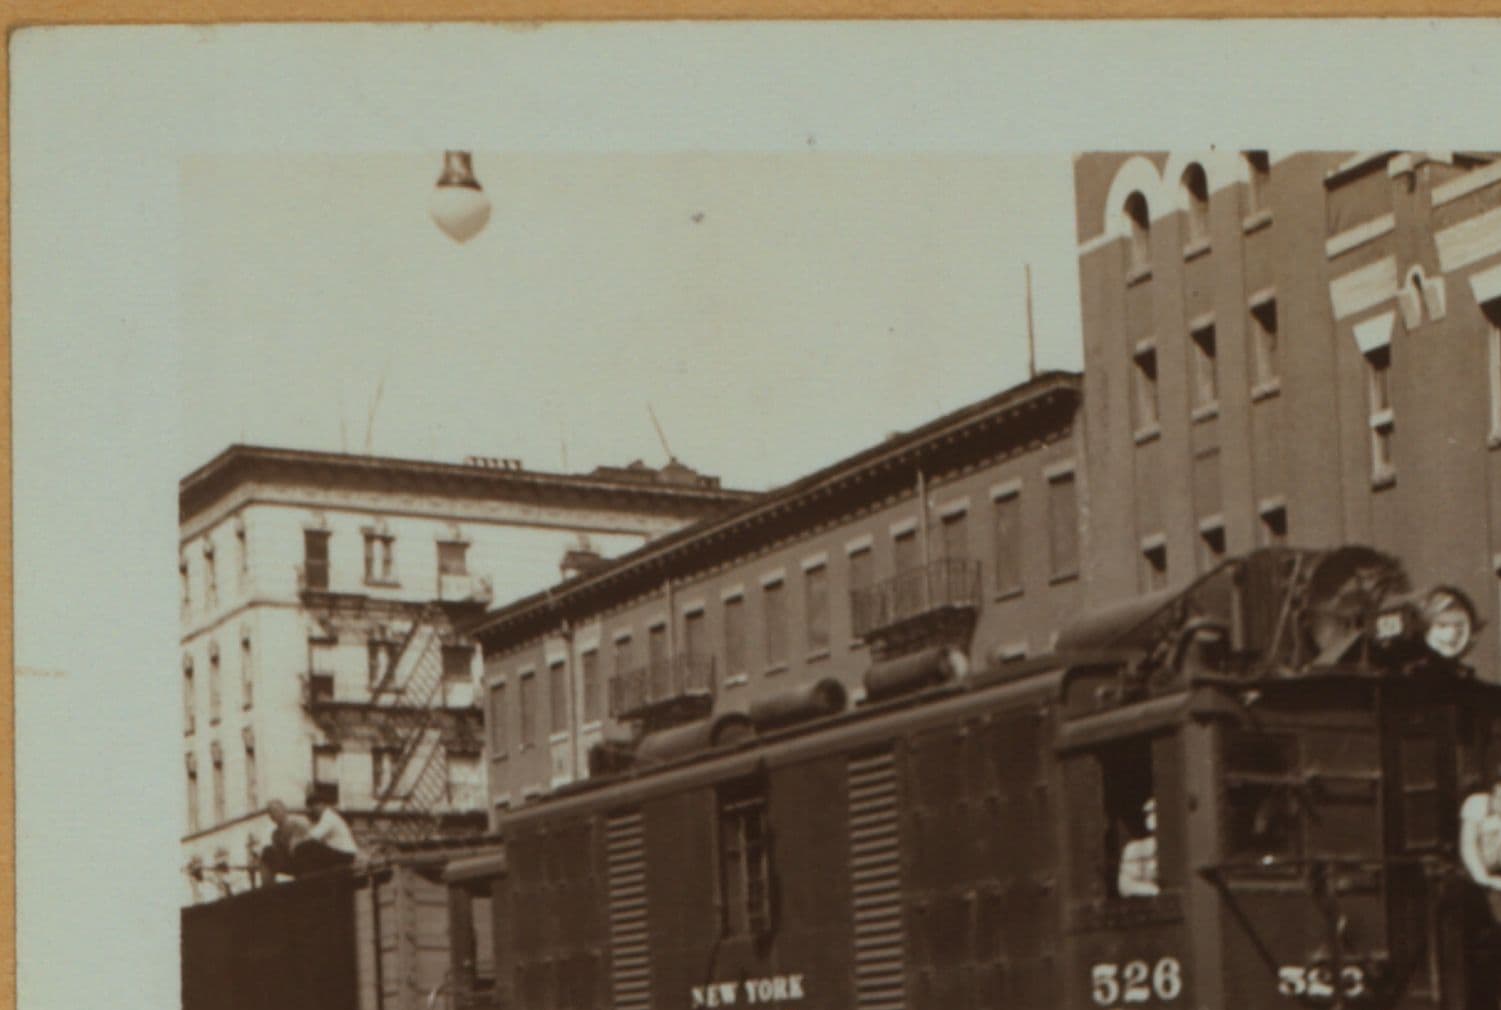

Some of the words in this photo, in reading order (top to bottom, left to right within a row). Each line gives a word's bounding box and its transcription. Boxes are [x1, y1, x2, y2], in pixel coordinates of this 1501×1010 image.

[691, 981, 738, 1009] NEW
[745, 973, 805, 1005] YORK
[1091, 956, 1183, 1006] 526
